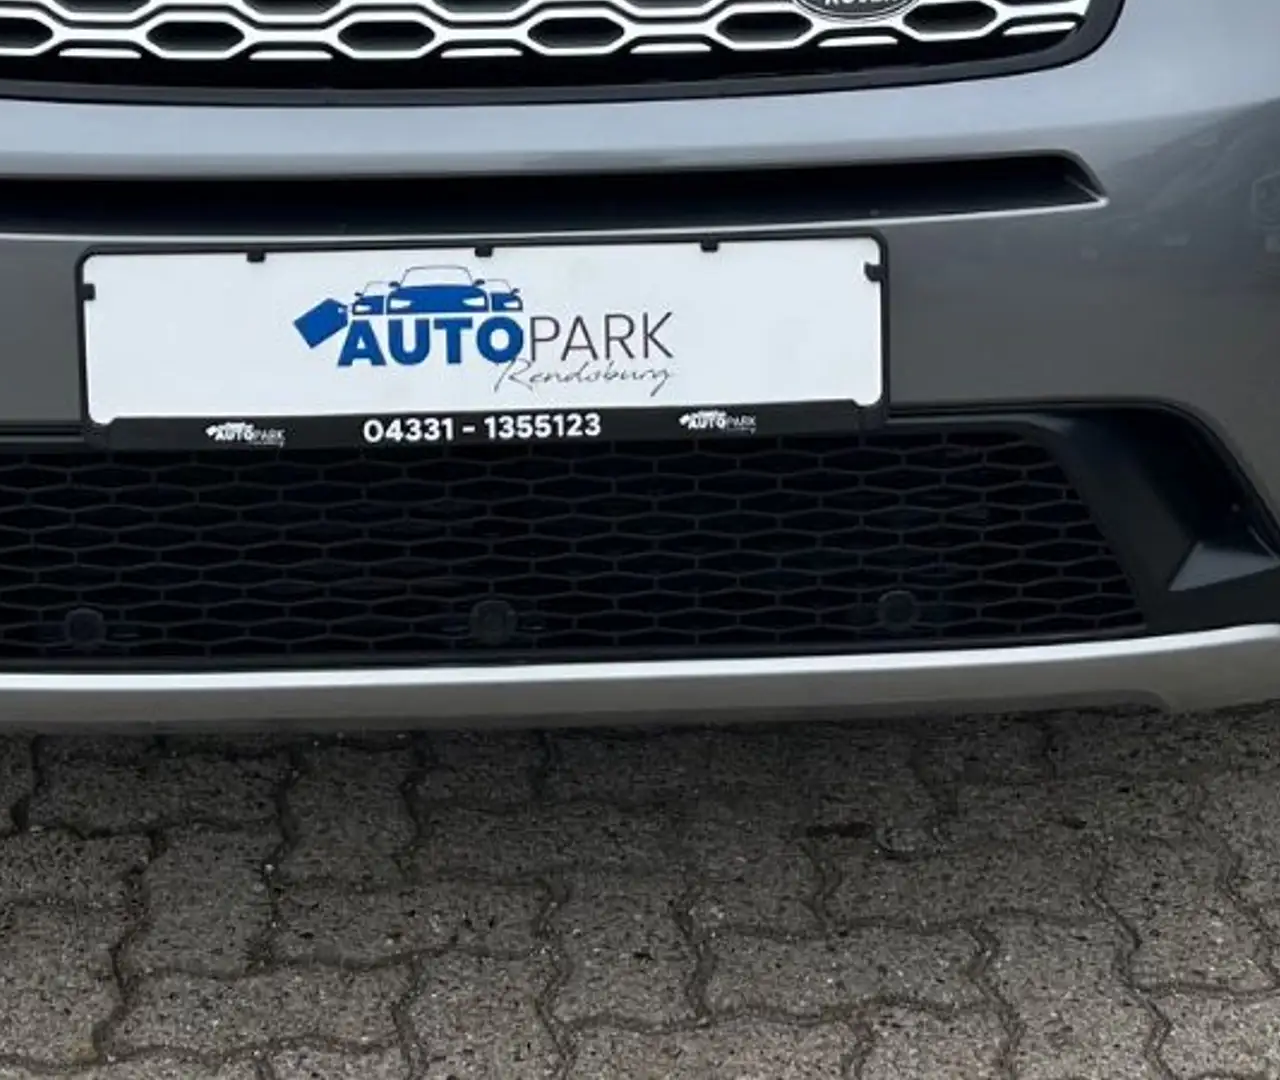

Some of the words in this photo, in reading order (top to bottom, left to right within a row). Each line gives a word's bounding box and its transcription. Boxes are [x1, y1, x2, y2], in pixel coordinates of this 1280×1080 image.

[493, 357, 675, 398] Rendsburg
[362, 416, 454, 444] 04331
[483, 412, 602, 439] 1355123
